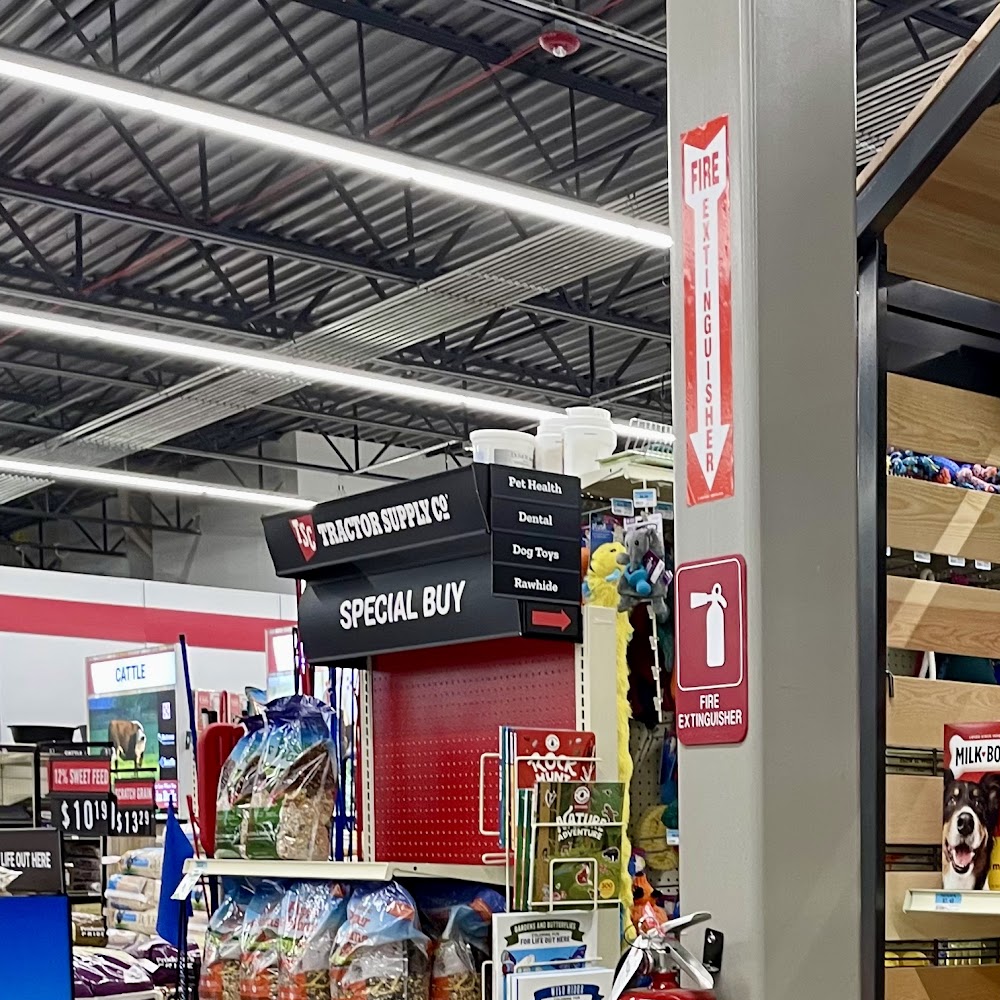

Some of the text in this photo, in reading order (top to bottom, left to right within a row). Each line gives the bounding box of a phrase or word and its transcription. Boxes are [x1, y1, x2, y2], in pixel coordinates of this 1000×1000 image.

[691, 151, 719, 195] FIRE
[702, 198, 716, 473] EXTINGUISHER
[508, 475, 563, 494] Pet Health
[291, 518, 317, 551] TSC
[317, 510, 383, 547] TRACTOR
[380, 496, 432, 534] SUPPLY
[518, 510, 553, 527] Dental
[512, 543, 560, 562] Dog Toys
[513, 577, 558, 593] Rawhide
[339, 579, 467, 631] SPECIAL BUY
[115, 663, 146, 683] CATTLE
[700, 693, 720, 710] FIRE
[678, 709, 742, 729] EXTINGUISHER
[956, 746, 982, 766] MILK
[54, 768, 109, 785] 12% SWEET FEED
[558, 827, 603, 842] ADVENTURE
[0, 851, 51, 869] LIFE OUT HERE
